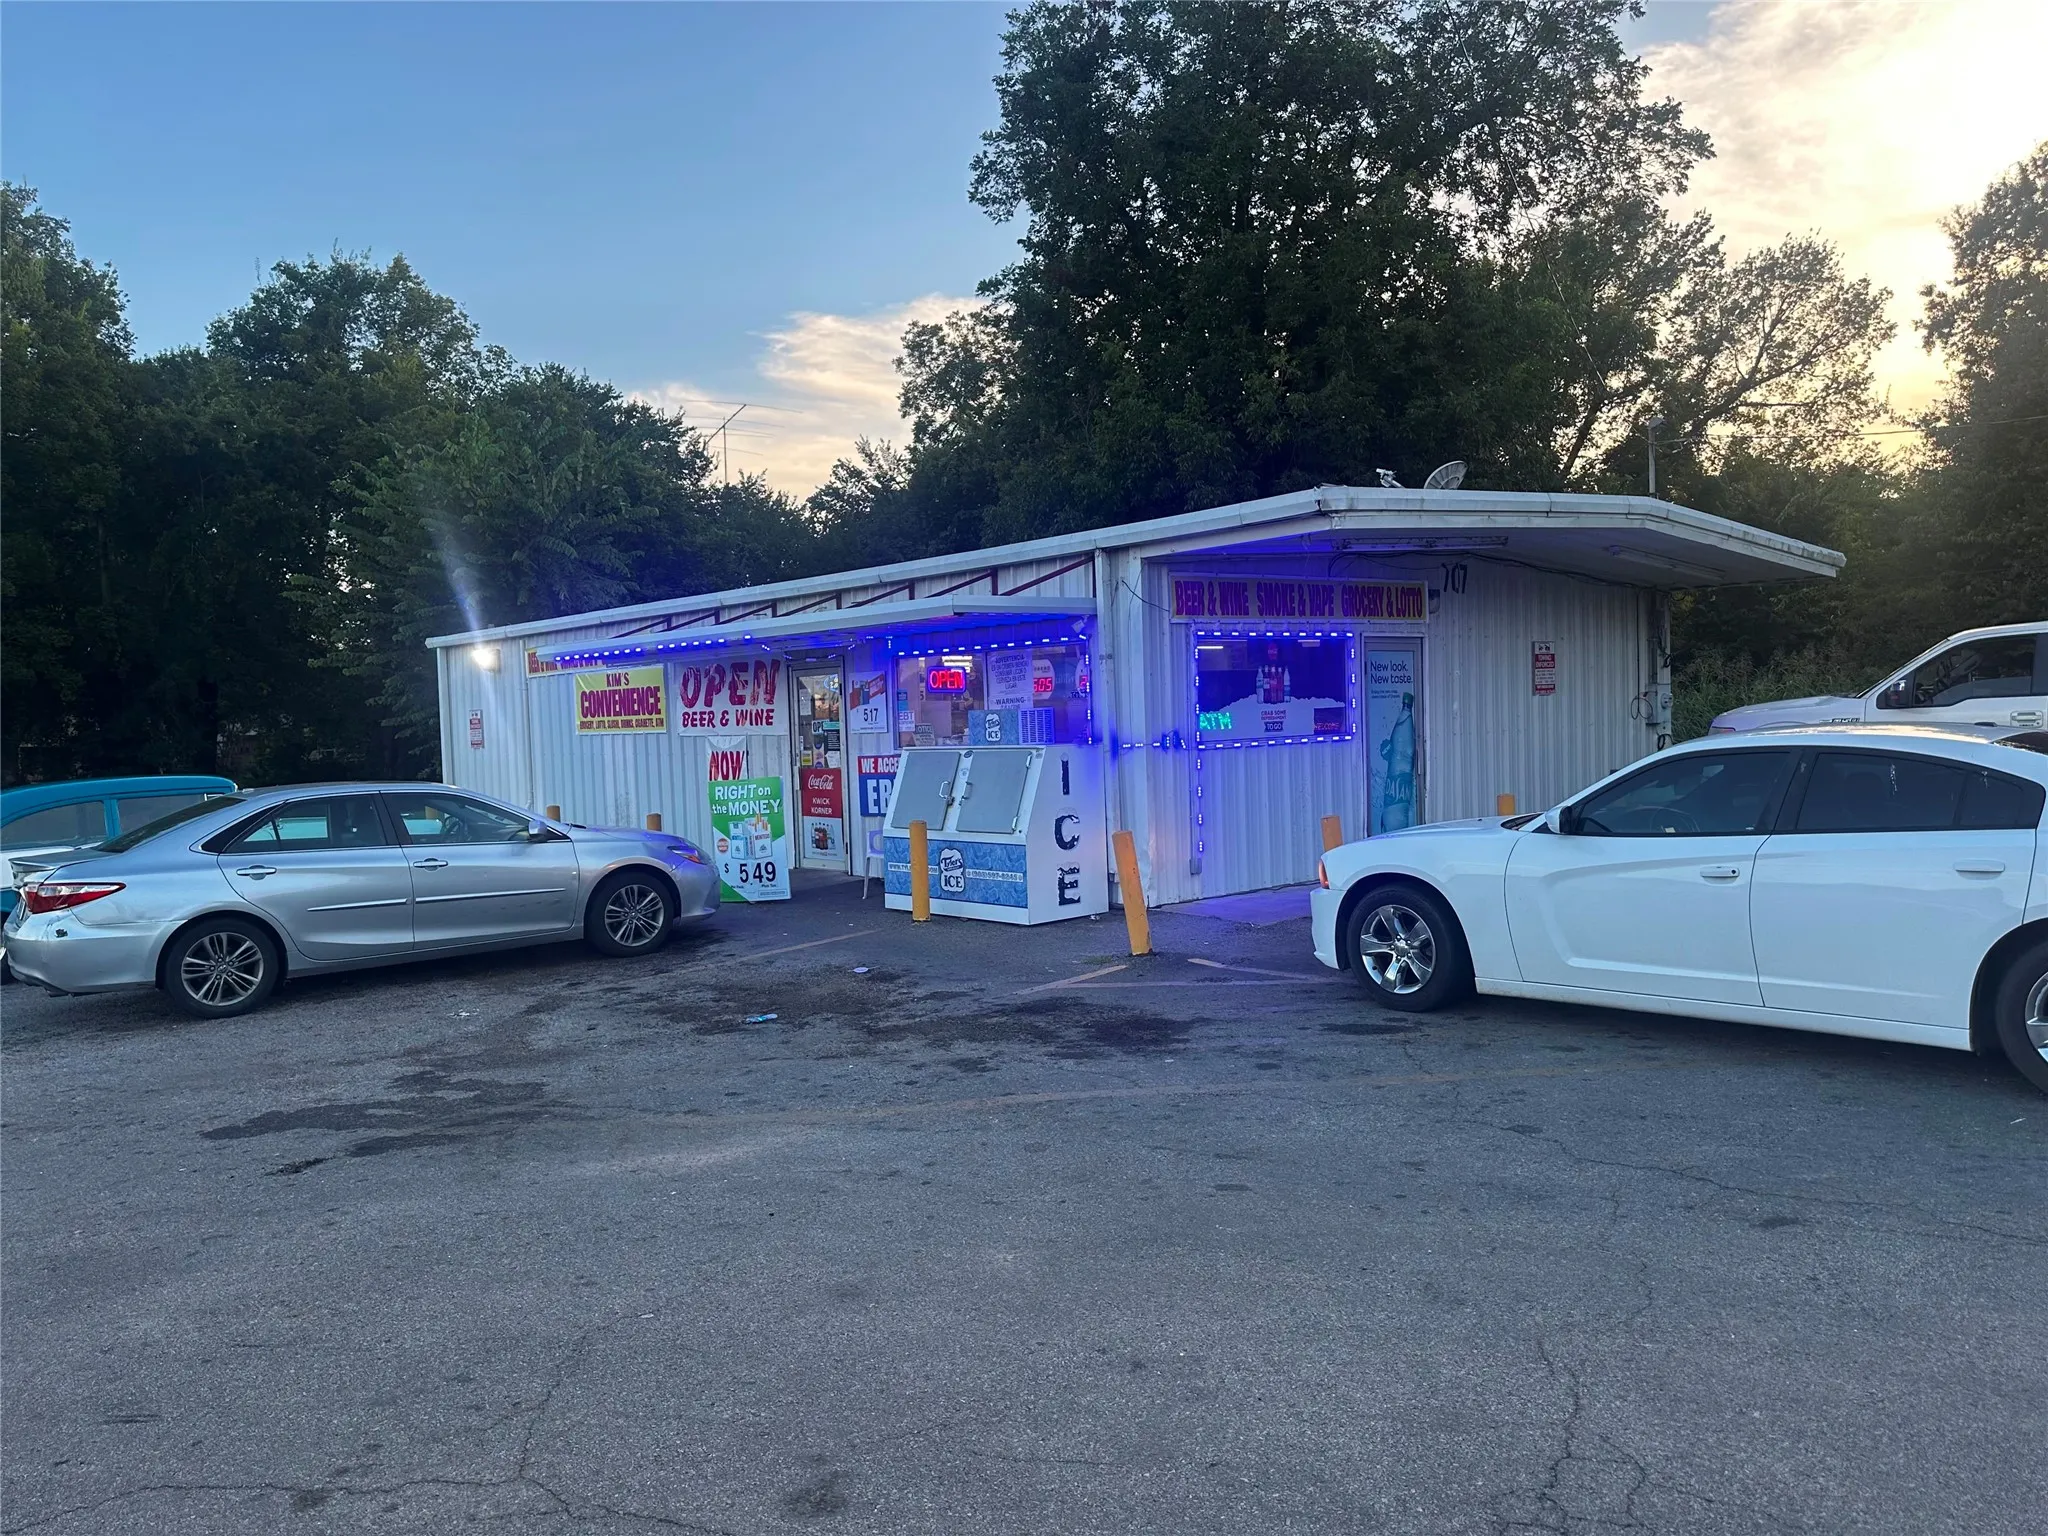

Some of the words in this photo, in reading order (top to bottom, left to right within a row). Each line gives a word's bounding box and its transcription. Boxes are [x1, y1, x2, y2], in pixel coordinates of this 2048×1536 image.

[1175, 580, 1205, 616] BEER
[1208, 581, 1217, 616] &
[1218, 581, 1249, 616] WINE
[1256, 581, 1295, 617] SMOKE
[1299, 583, 1305, 617] &
[1307, 584, 1335, 617] VAPE
[1341, 584, 1384, 618] GROCERY
[1386, 587, 1394, 618] &
[1396, 587, 1423, 618] LOTTO
[1371, 660, 1389, 671] New
[1390, 660, 1408, 671] look.
[606, 672, 630, 687] KIM'S
[680, 659, 780, 708] OPEN
[930, 670, 963, 689] OPEN
[1371, 673, 1389, 684] New
[1391, 673, 1413, 684] taste.
[580, 686, 662, 718] CONVENIENCE
[682, 709, 716, 728] BEER
[720, 709, 729, 727] &
[735, 708, 775, 727] WINE
[863, 708, 879, 721] 517
[1199, 712, 1232, 730] ATM
[988, 730, 999, 739] ICE
[709, 751, 745, 781] NOW
[861, 758, 876, 773] WE
[878, 757, 899, 773] ACCE
[808, 774, 834, 790] Coca-Cola
[1386, 777, 1412, 802] DASAN
[715, 784, 756, 800] RIGHT
[758, 787, 771, 796] on
[866, 779, 894, 814] EB
[712, 804, 727, 814] the
[729, 799, 780, 815] MONEY
[812, 797, 830, 805] KWICK
[811, 807, 832, 815] KORNER
[1054, 753, 1081, 906] ICE
[724, 863, 730, 873] $
[943, 875, 963, 888] ICE
